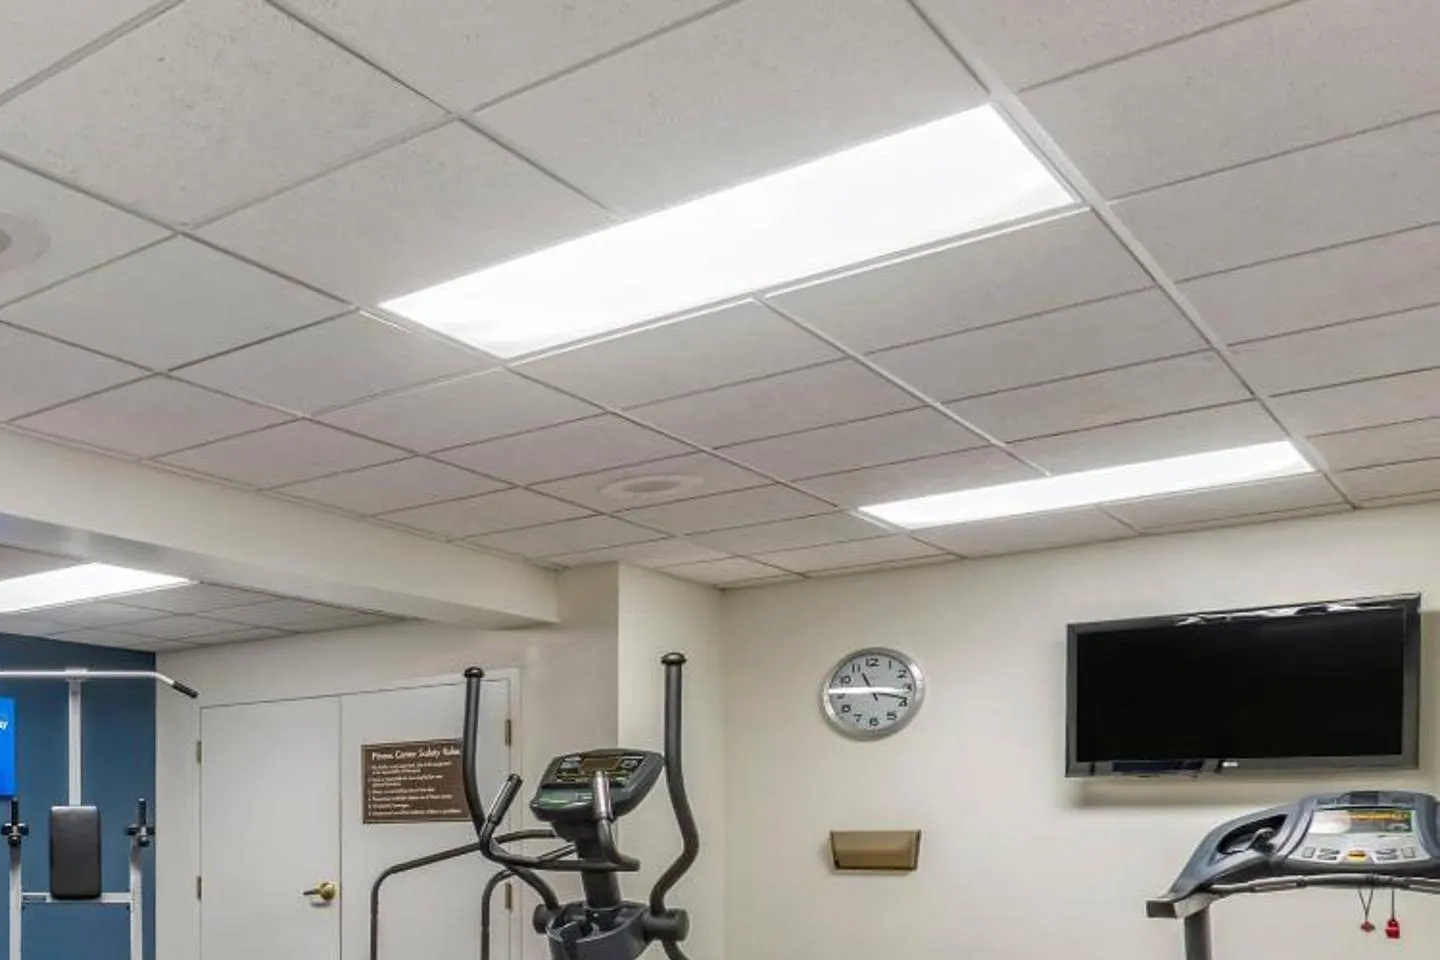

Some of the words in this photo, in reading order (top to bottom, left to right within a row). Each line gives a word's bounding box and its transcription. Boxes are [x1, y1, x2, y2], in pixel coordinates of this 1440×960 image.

[865, 658, 879, 667] 12
[852, 663, 861, 673] 11
[897, 669, 908, 678] 2
[853, 713, 862, 723] 7
